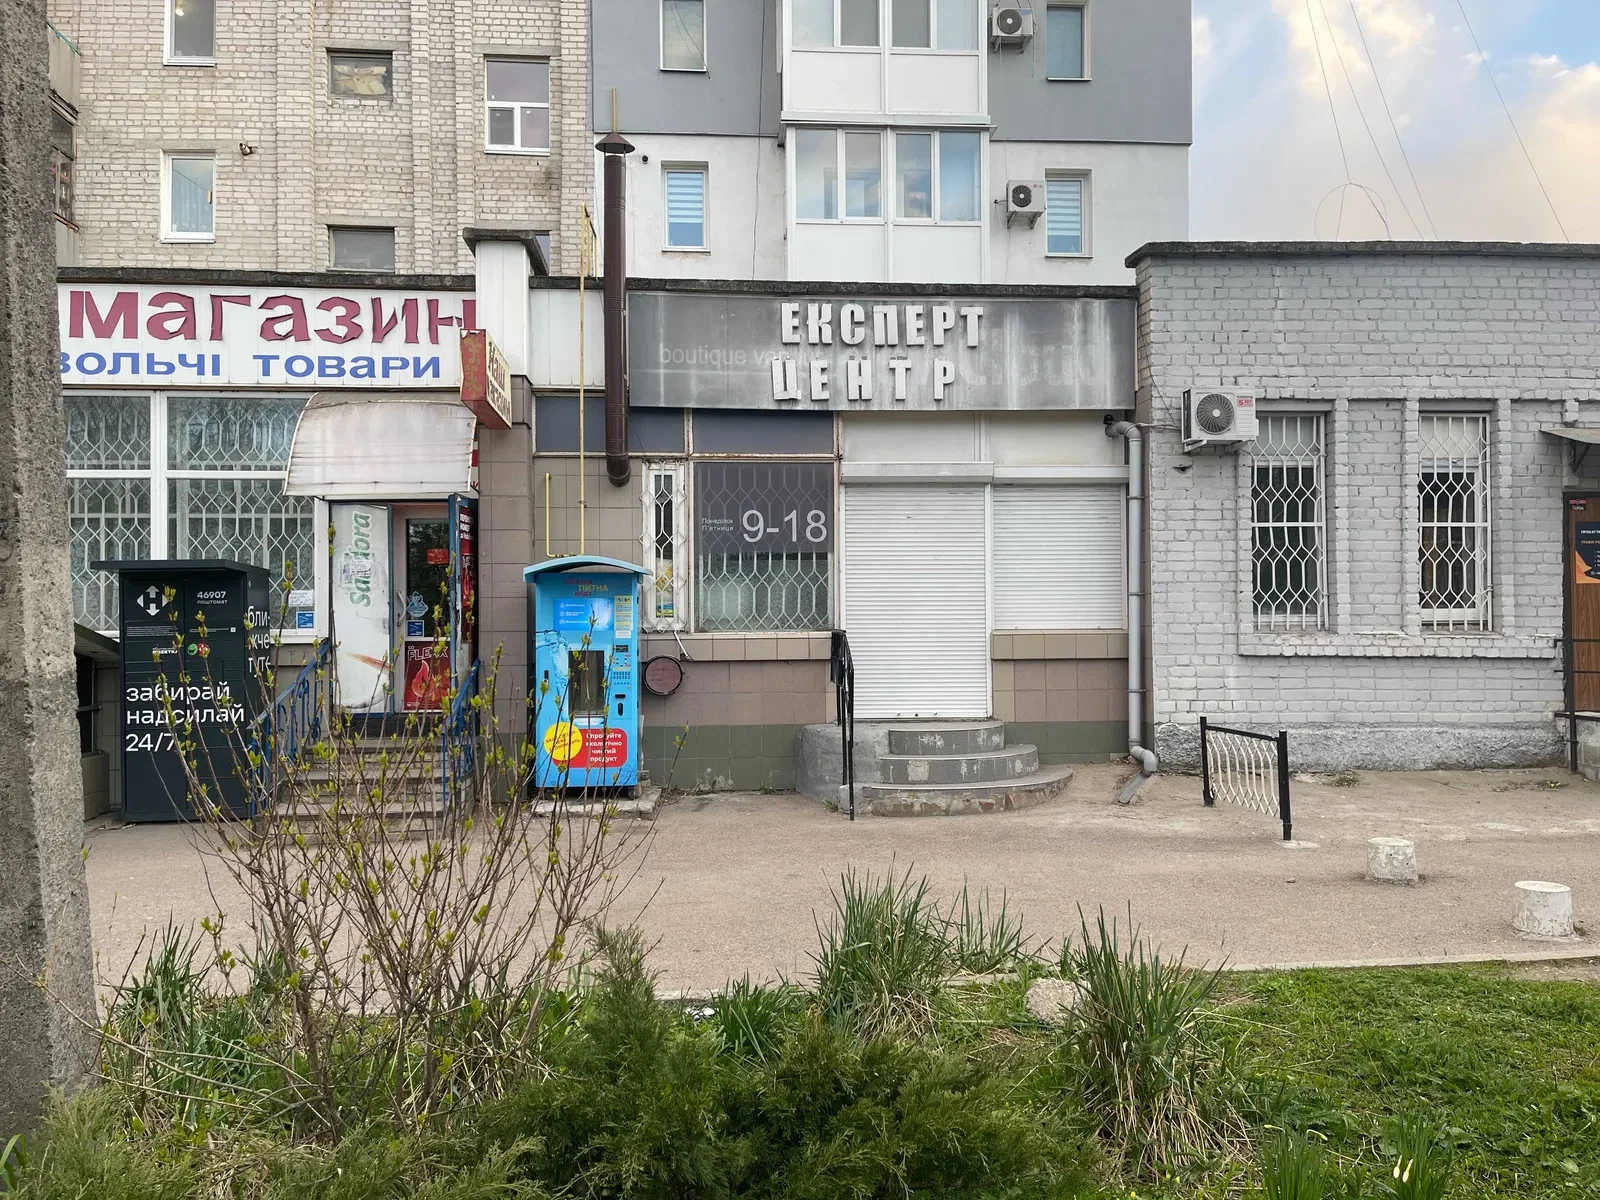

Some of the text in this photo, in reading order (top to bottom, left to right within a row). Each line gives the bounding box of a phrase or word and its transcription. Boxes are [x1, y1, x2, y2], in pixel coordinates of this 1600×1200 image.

[780, 302, 985, 347] ЕКСПЕРТ
[253, 355, 441, 378] товари
[660, 344, 746, 370] boutique
[771, 357, 956, 402] ЦЕНТР
[742, 509, 827, 543] 9-18
[349, 512, 371, 607] Sadora
[197, 591, 226, 599] 46907
[578, 584, 608, 592] ПИТНА
[126, 681, 230, 705] забирай
[127, 703, 245, 727] надсилай
[126, 732, 175, 752] 24/7
